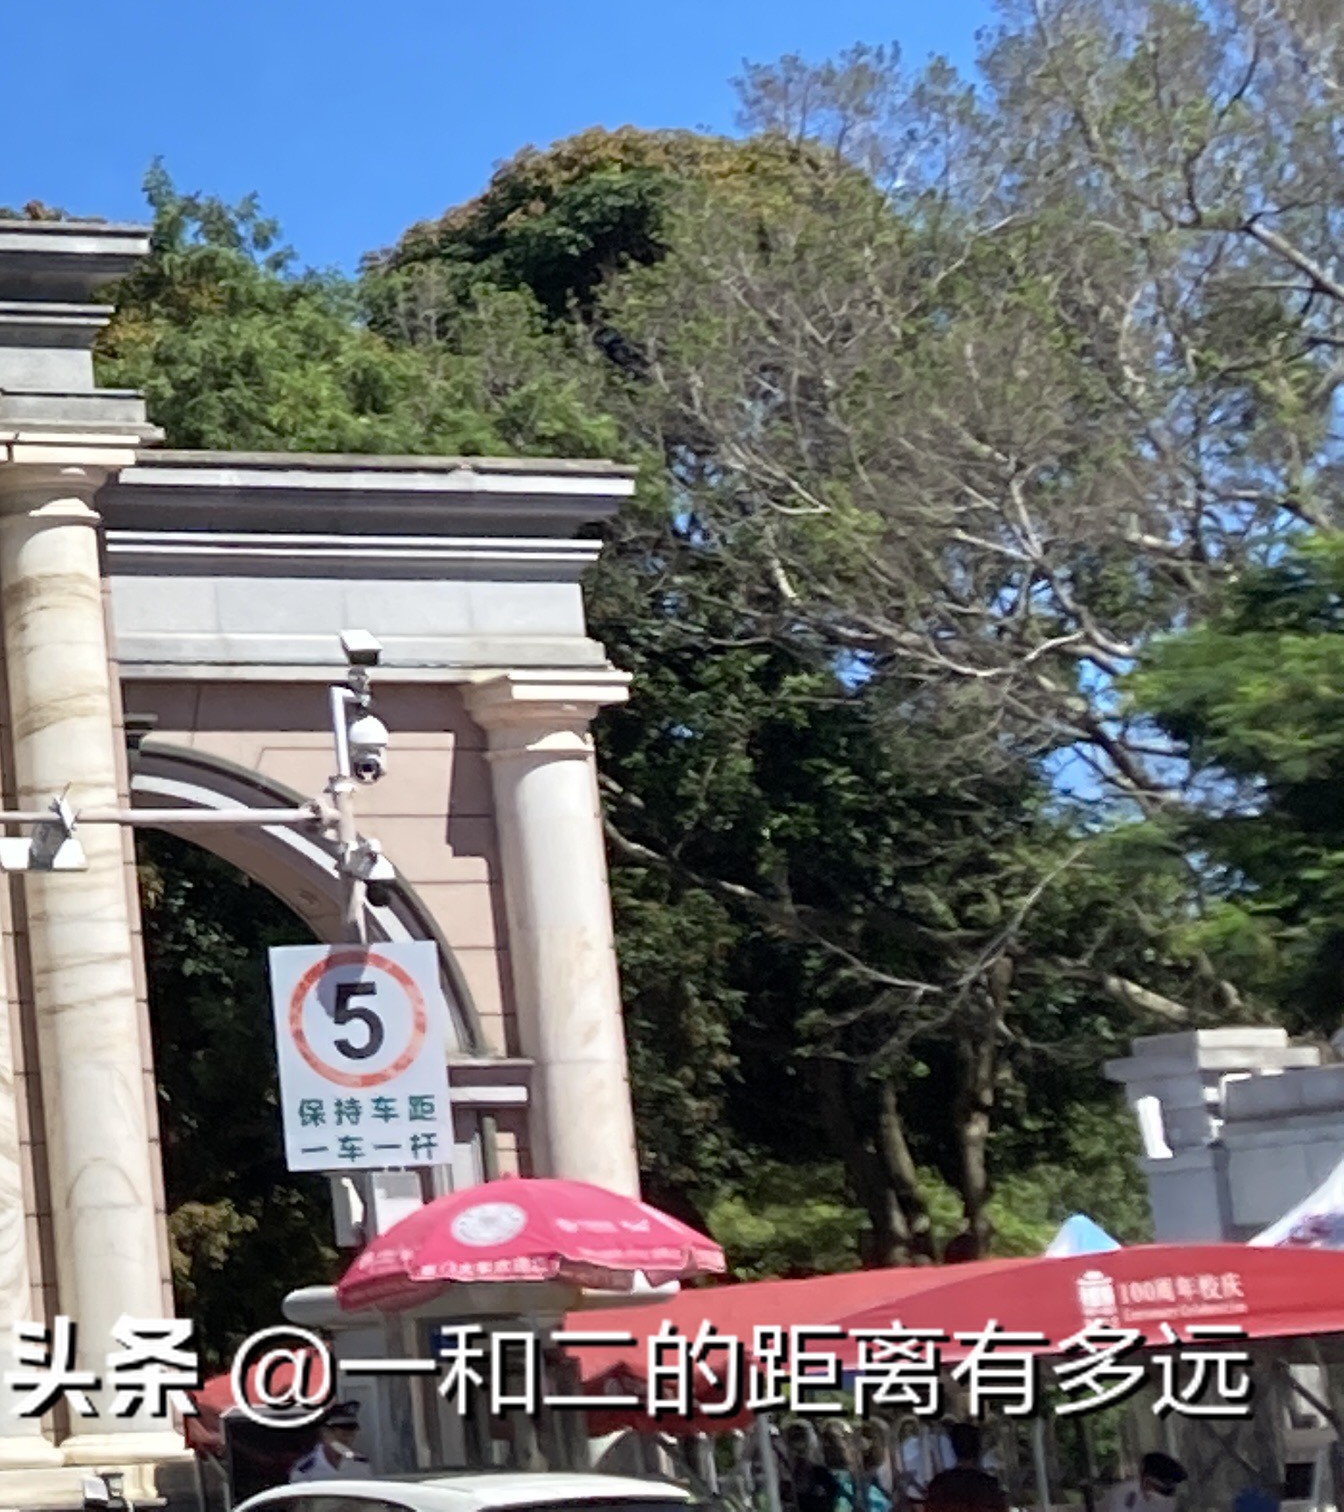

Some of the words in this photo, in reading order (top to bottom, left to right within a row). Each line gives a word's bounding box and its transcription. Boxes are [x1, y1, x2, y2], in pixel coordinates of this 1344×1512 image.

[333, 981, 384, 1060] 5
[298, 1094, 437, 1127] 保持车距
[301, 1133, 438, 1162] 一车一杆
